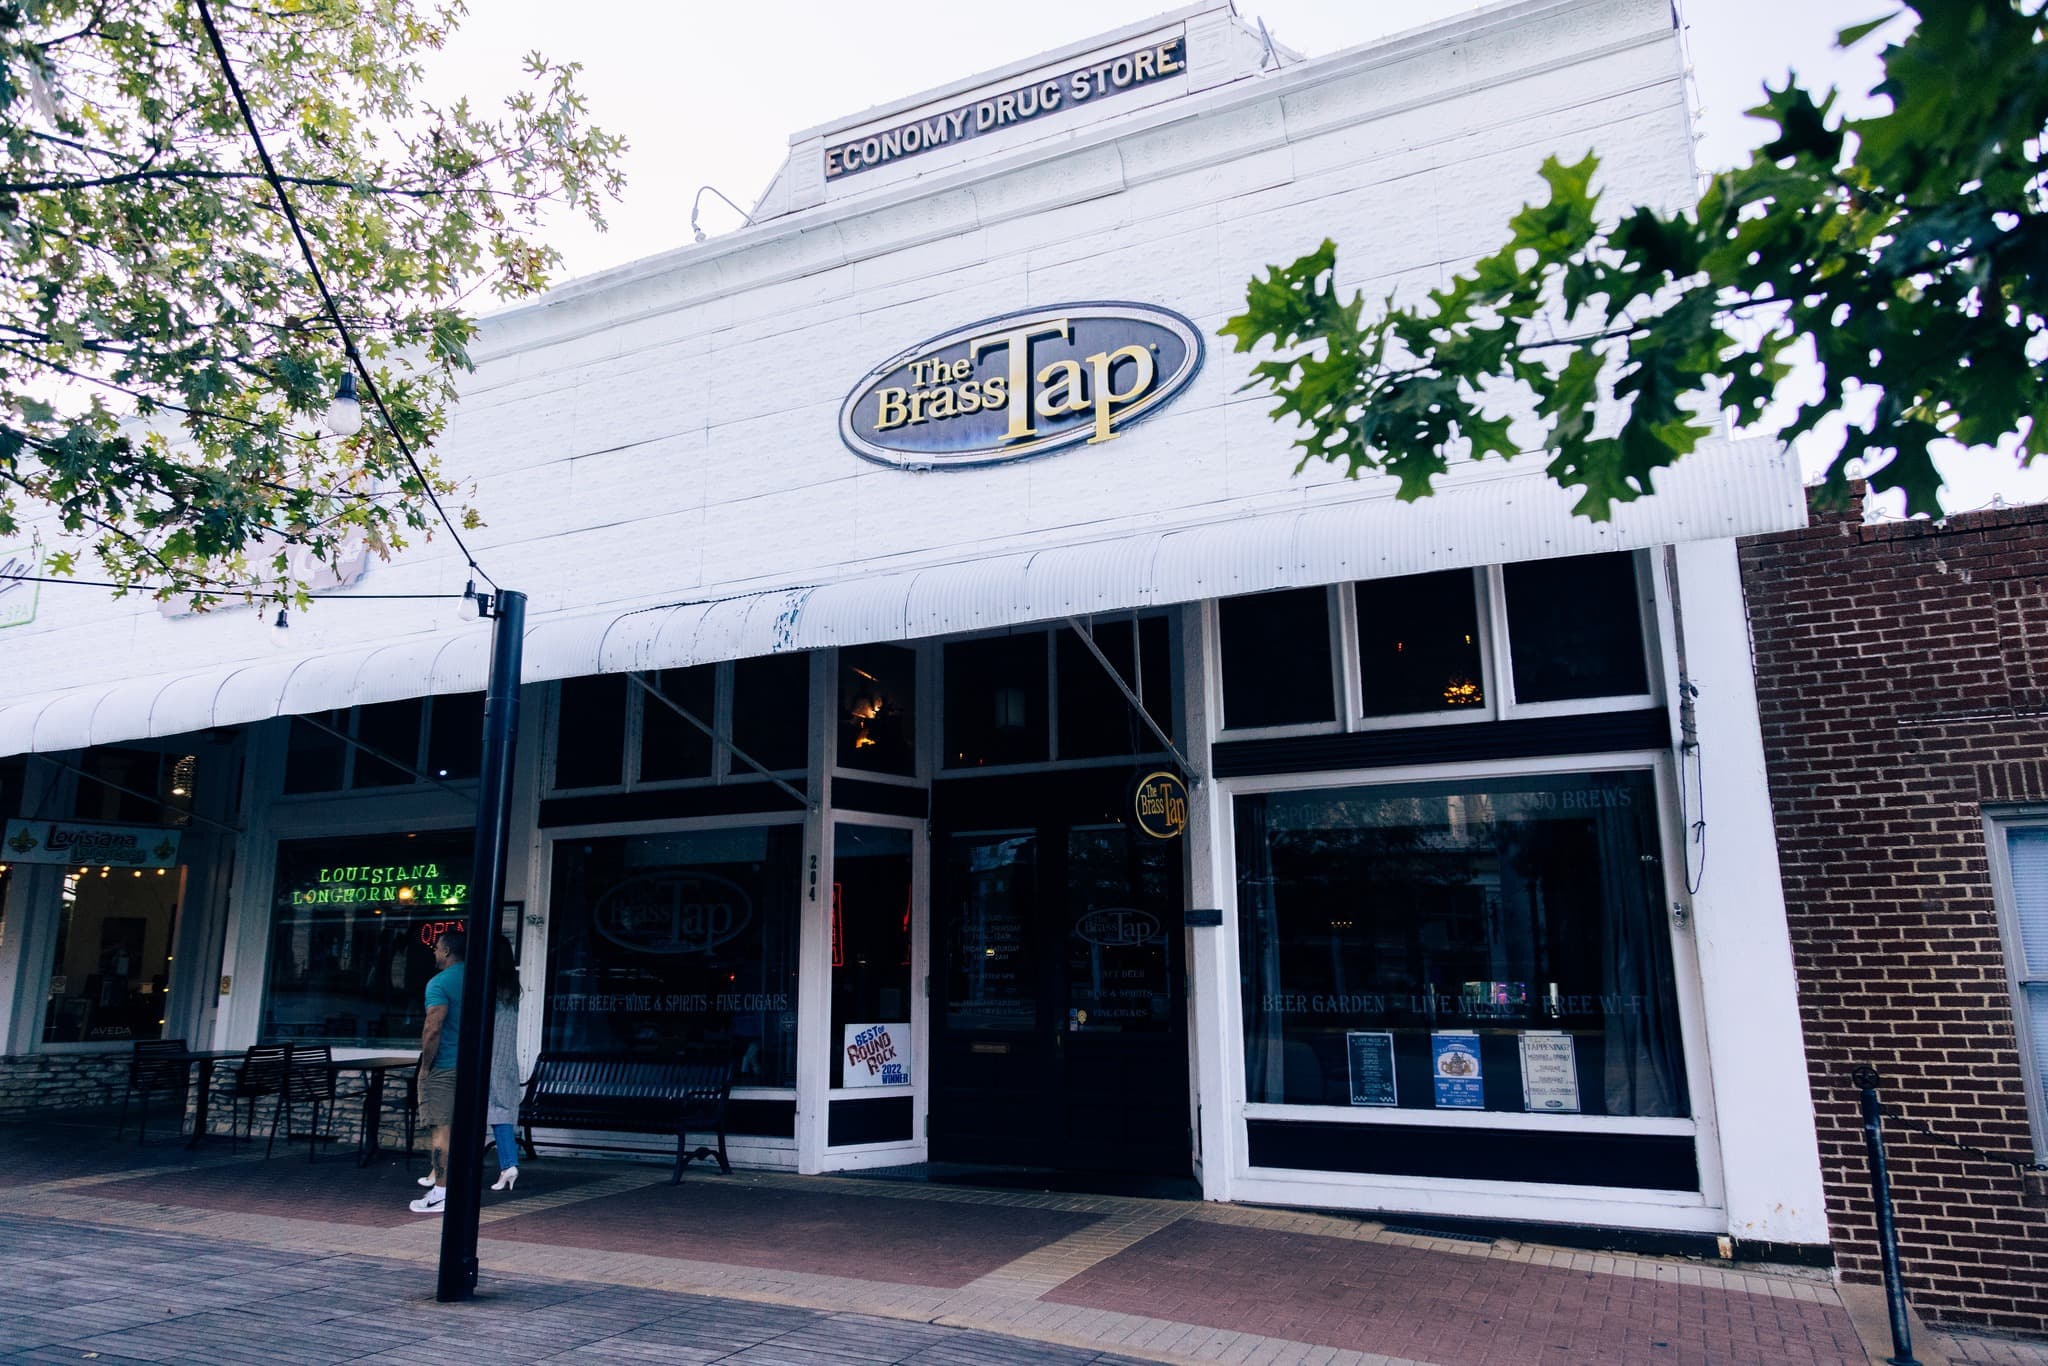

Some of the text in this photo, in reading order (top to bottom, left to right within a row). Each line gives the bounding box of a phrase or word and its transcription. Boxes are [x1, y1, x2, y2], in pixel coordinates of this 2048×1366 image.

[826, 108, 970, 178] ECONOMY
[976, 83, 1062, 131] DRUG
[873, 318, 1155, 445] Brass Tap
[908, 356, 971, 388] The
[1146, 784, 1158, 798] The
[1562, 786, 1632, 809] BREWS
[1140, 783, 1185, 836] Brass Tap
[44, 825, 138, 851] Louisiana
[319, 863, 440, 885] LOUISIANA
[808, 854, 817, 902] 204
[292, 886, 398, 905] LONGHORN
[608, 879, 733, 957] Bass Tap
[1107, 911, 1152, 948] Tap
[420, 920, 465, 946] OP
[553, 993, 789, 1012] CRAFT BEER WINE & SPIRITS FINE CIGARS
[1262, 994, 1307, 1013] BEER
[1311, 994, 1385, 1014] GARDEN
[1411, 994, 1452, 1013] LIVE
[1458, 995, 1515, 1014] MUSIC
[1541, 995, 1594, 1014] FREE
[90, 1026, 132, 1036] AVEDA
[855, 1025, 878, 1047] BEST
[847, 1032, 892, 1067] ROUND
[866, 1046, 897, 1076] ROCK
[882, 1063, 902, 1074] 2022
[882, 1073, 909, 1084] WINNER
